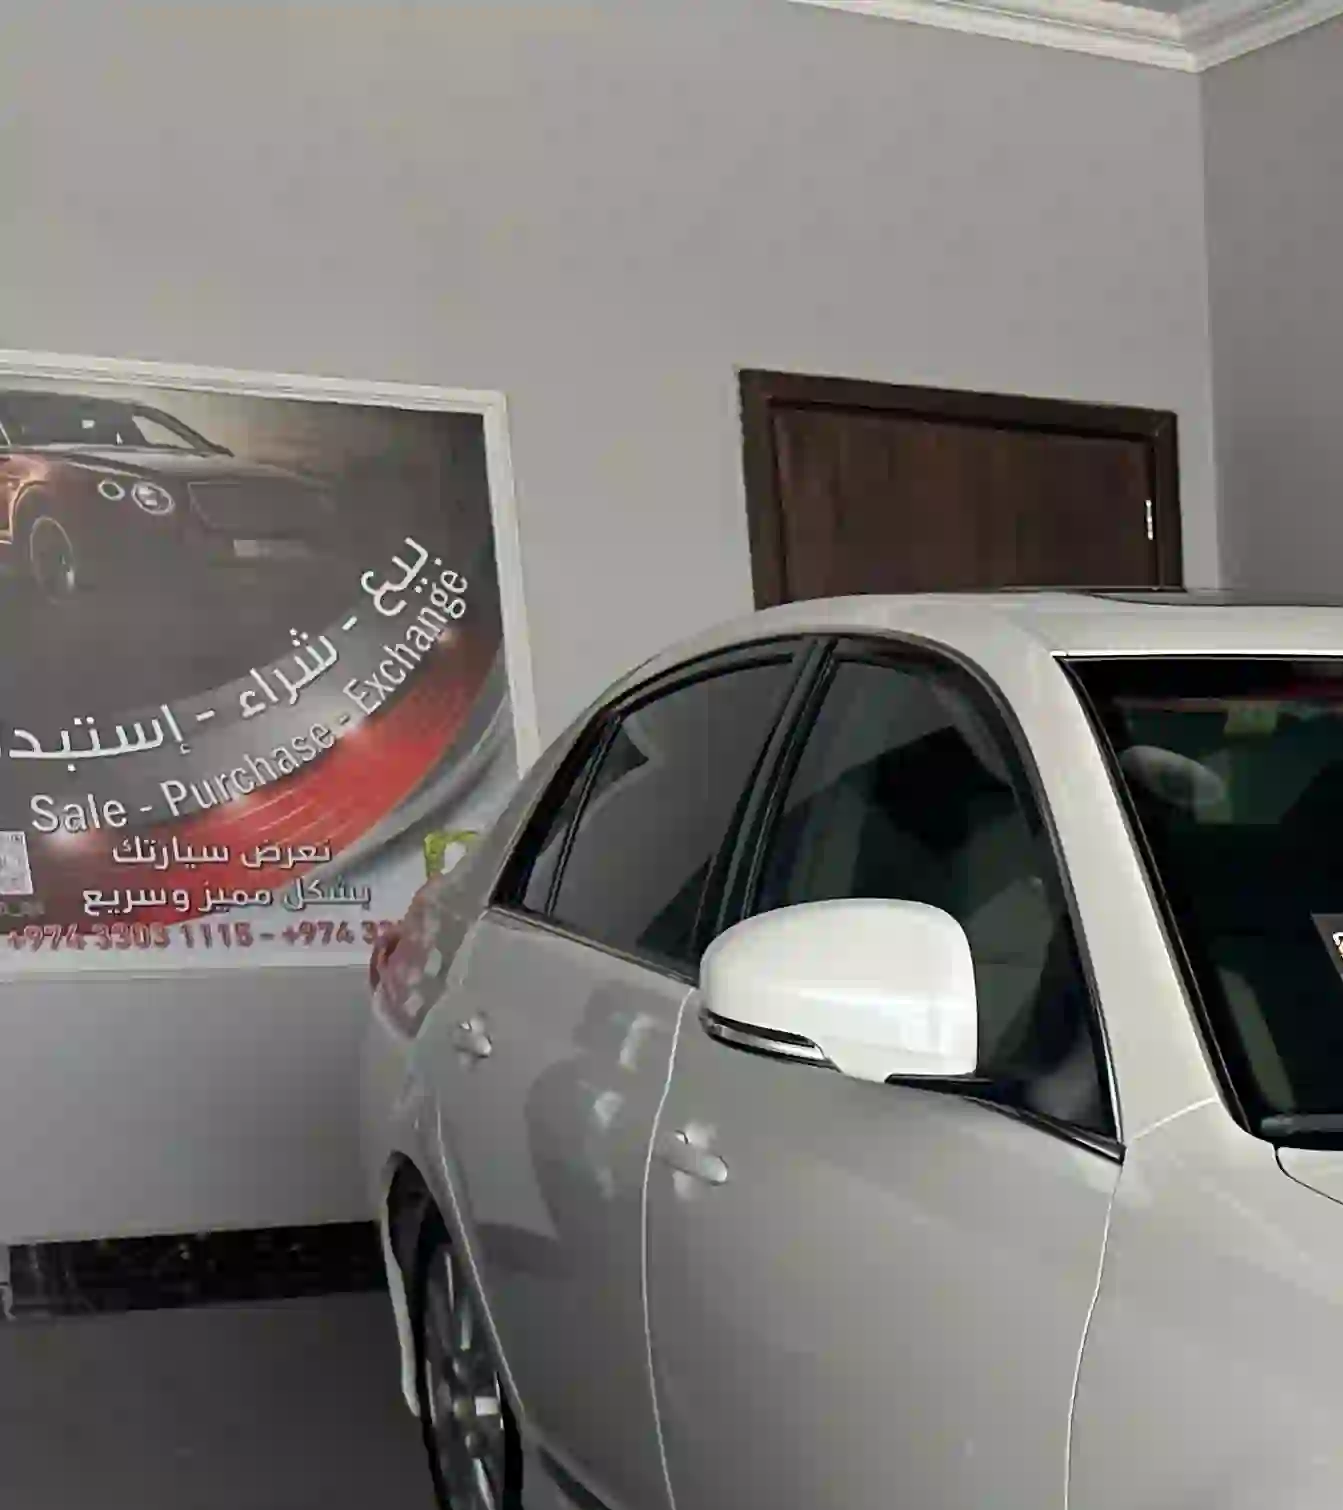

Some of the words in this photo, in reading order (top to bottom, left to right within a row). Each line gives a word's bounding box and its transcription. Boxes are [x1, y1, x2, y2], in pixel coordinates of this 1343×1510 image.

[361, 537, 443, 617] بيع
[239, 628, 338, 718] شراء
[29, 794, 129, 835] Sale
[160, 723, 336, 818] Purchase
[343, 570, 468, 717] Exchange
[0, 705, 191, 772] إستبد
[111, 835, 229, 871] سيارتك
[82, 888, 191, 917] وسريع
[200, 881, 275, 914] مميز
[283, 875, 373, 914] بشكل
[7, 923, 88, 952] +974
[281, 920, 355, 946] +974
